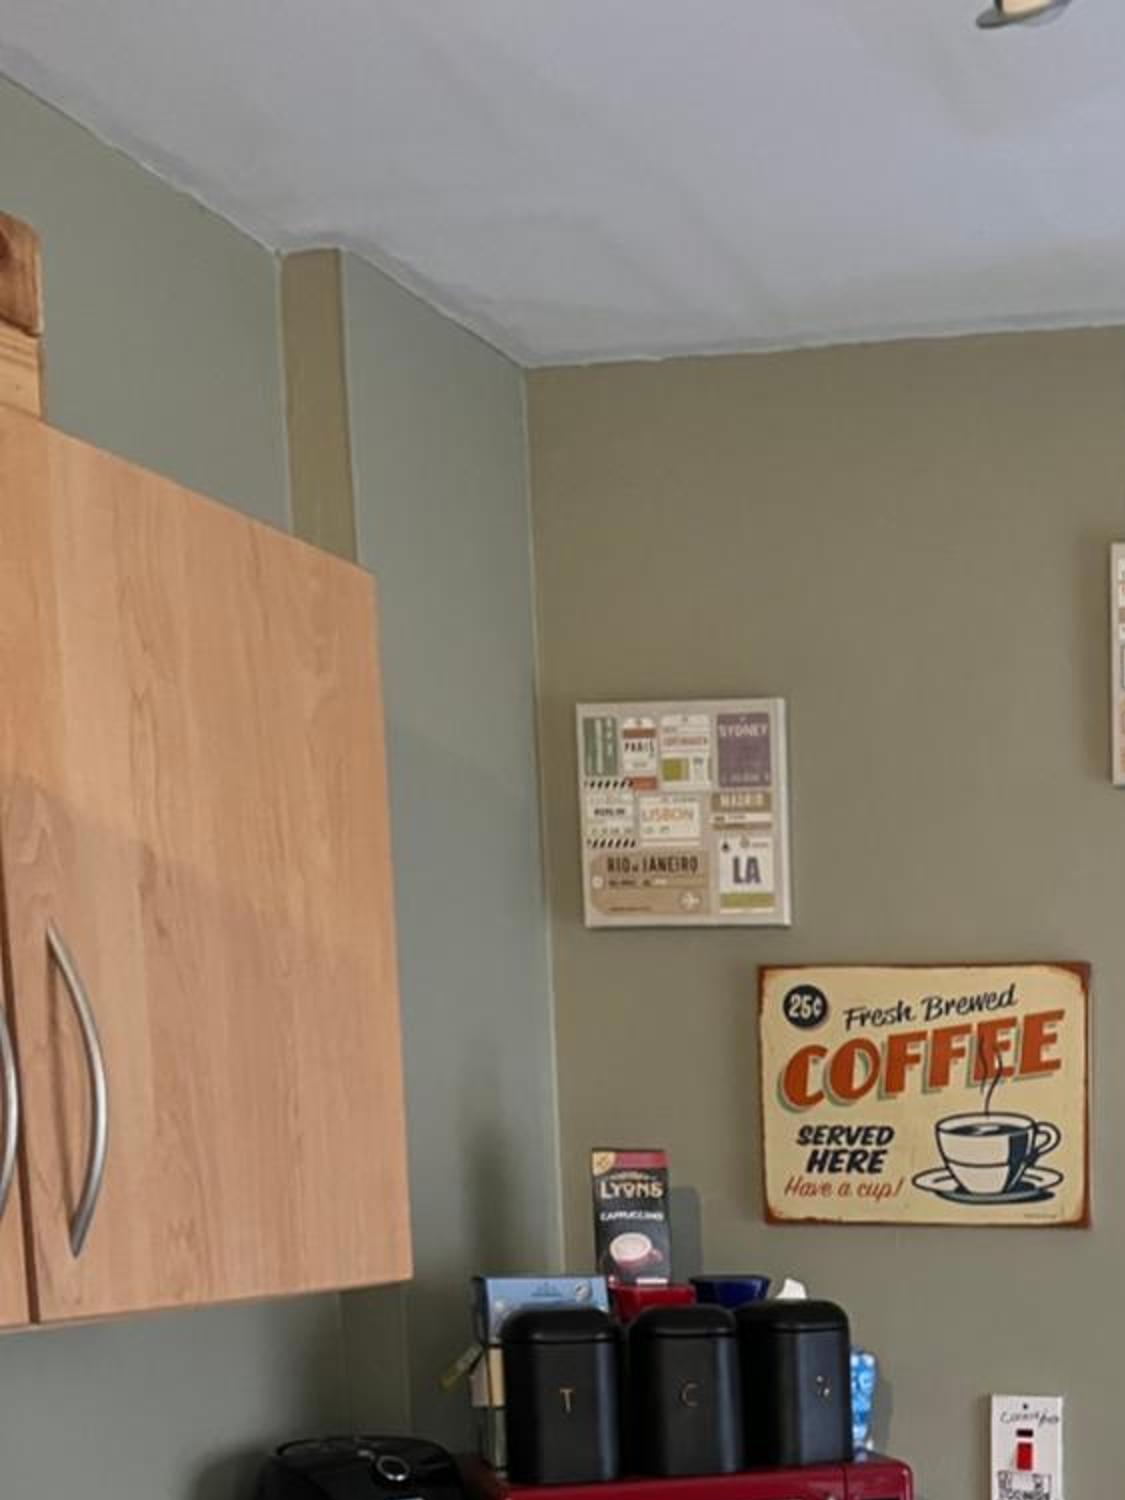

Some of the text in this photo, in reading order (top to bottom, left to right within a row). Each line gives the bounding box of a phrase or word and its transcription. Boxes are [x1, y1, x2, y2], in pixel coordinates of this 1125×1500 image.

[718, 722, 769, 738] SYDNEY
[607, 857, 631, 874] RIO
[642, 855, 699, 874] JANEIRO
[732, 855, 762, 885] LA
[787, 993, 823, 1019] 25¢
[843, 983, 1018, 1031] Fresh Brewed
[780, 1008, 1066, 1110] COFFEE
[796, 1125, 896, 1148] SERVED
[806, 1150, 888, 1175] HERE
[600, 1180, 664, 1199] LYONS
[784, 1175, 905, 1204] Have a cup!
